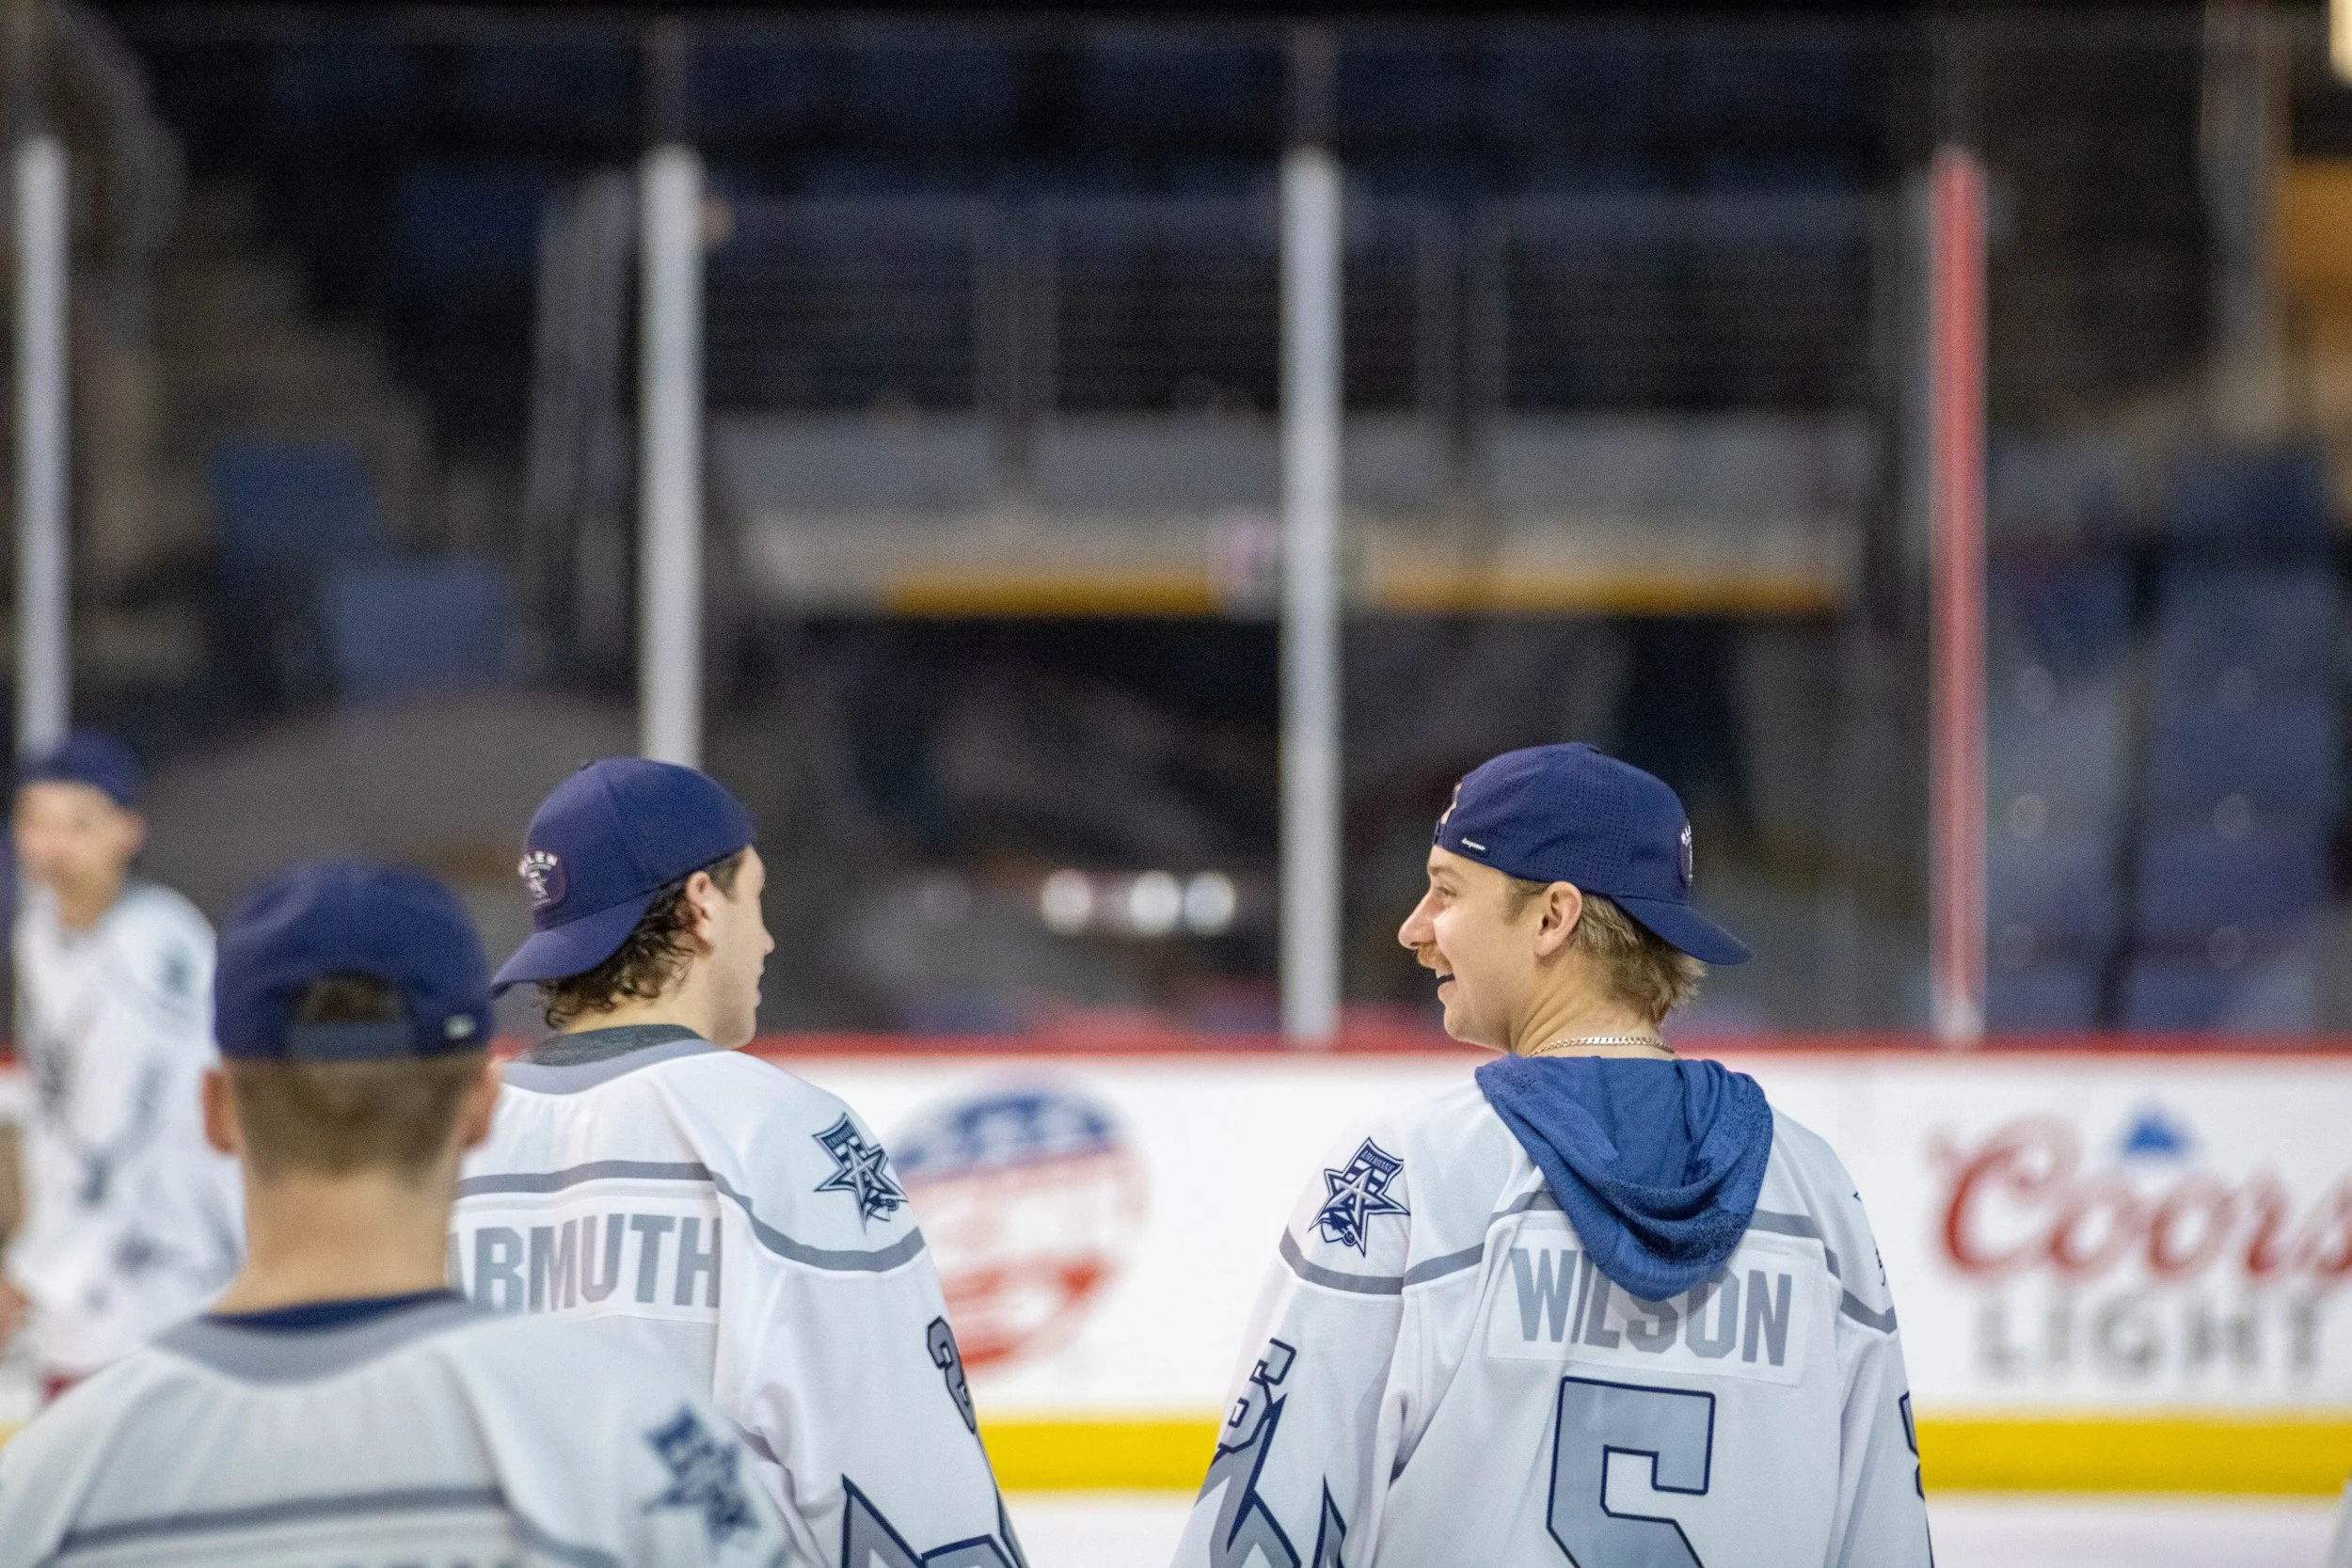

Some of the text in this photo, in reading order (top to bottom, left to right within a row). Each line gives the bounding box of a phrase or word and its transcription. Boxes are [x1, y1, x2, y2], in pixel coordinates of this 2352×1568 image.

[1509, 1247, 1792, 1367] WILSON
[1974, 1294, 2334, 1381] LIGHT
[1546, 1375, 1716, 1568] 5
